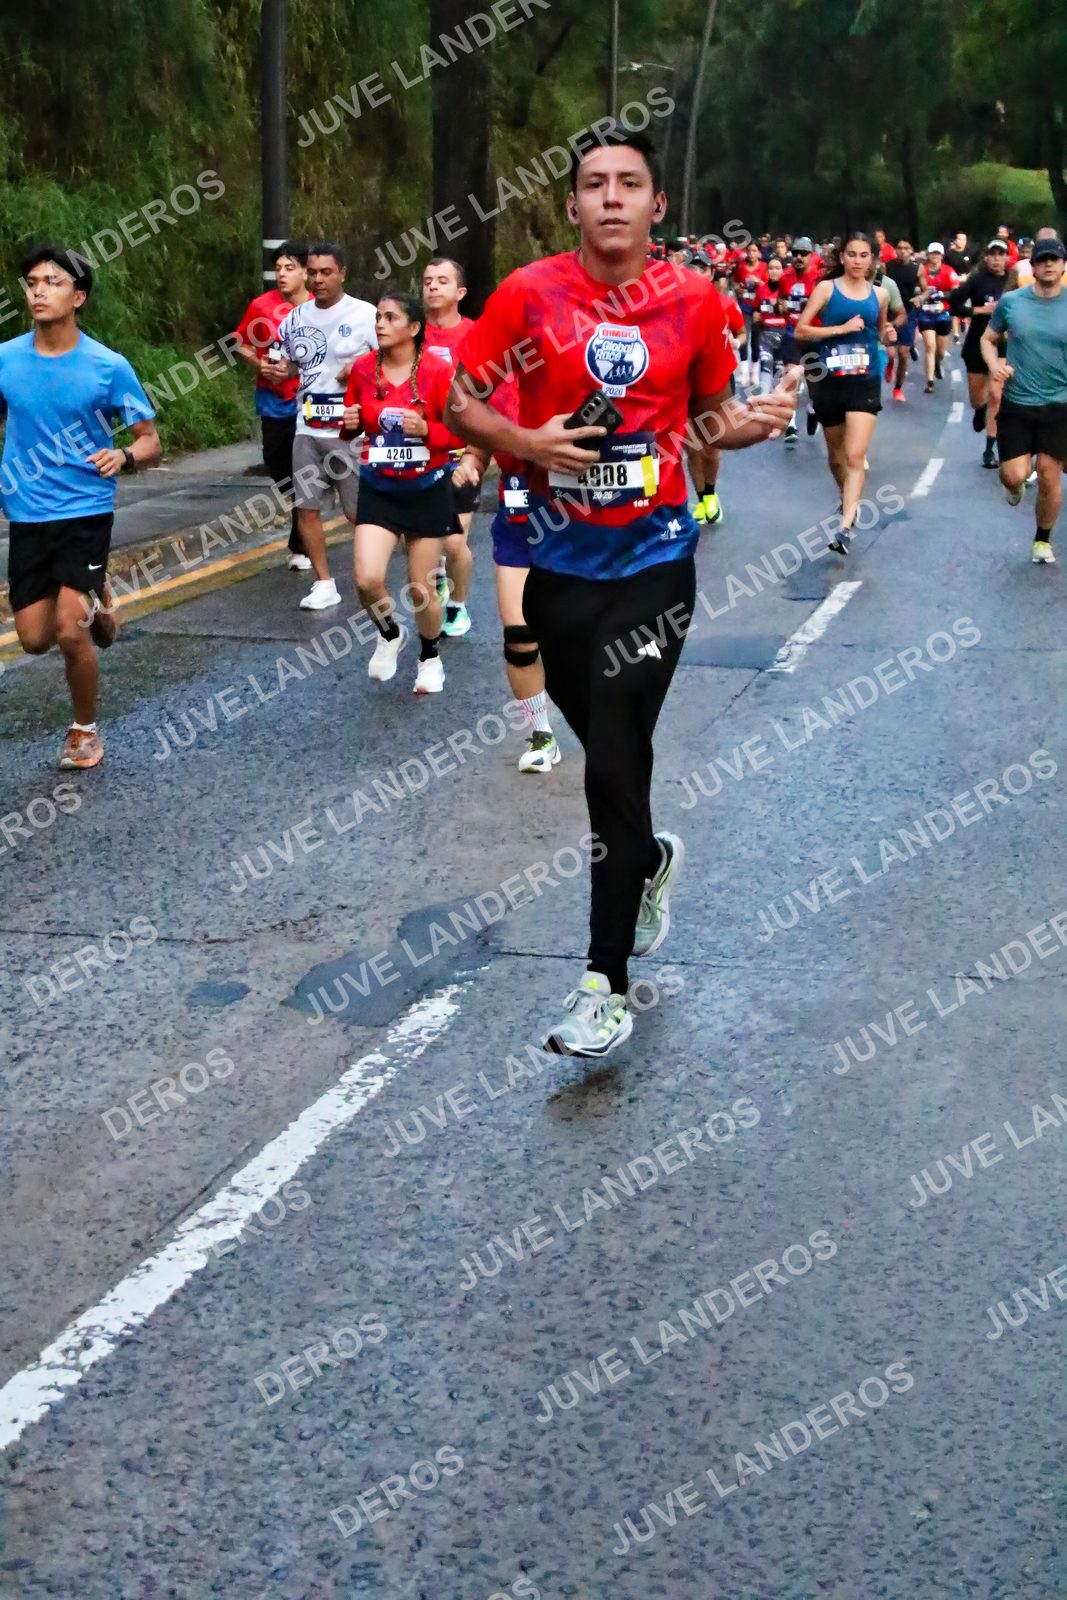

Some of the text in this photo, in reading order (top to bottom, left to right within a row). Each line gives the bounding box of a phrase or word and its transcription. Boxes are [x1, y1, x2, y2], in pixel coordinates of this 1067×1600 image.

[602, 341, 634, 353] Global
[595, 349, 622, 361] Race
[605, 386, 623, 395] 2026
[315, 406, 335, 415] 4847
[386, 448, 413, 460] 4240
[577, 464, 628, 487] 4908
